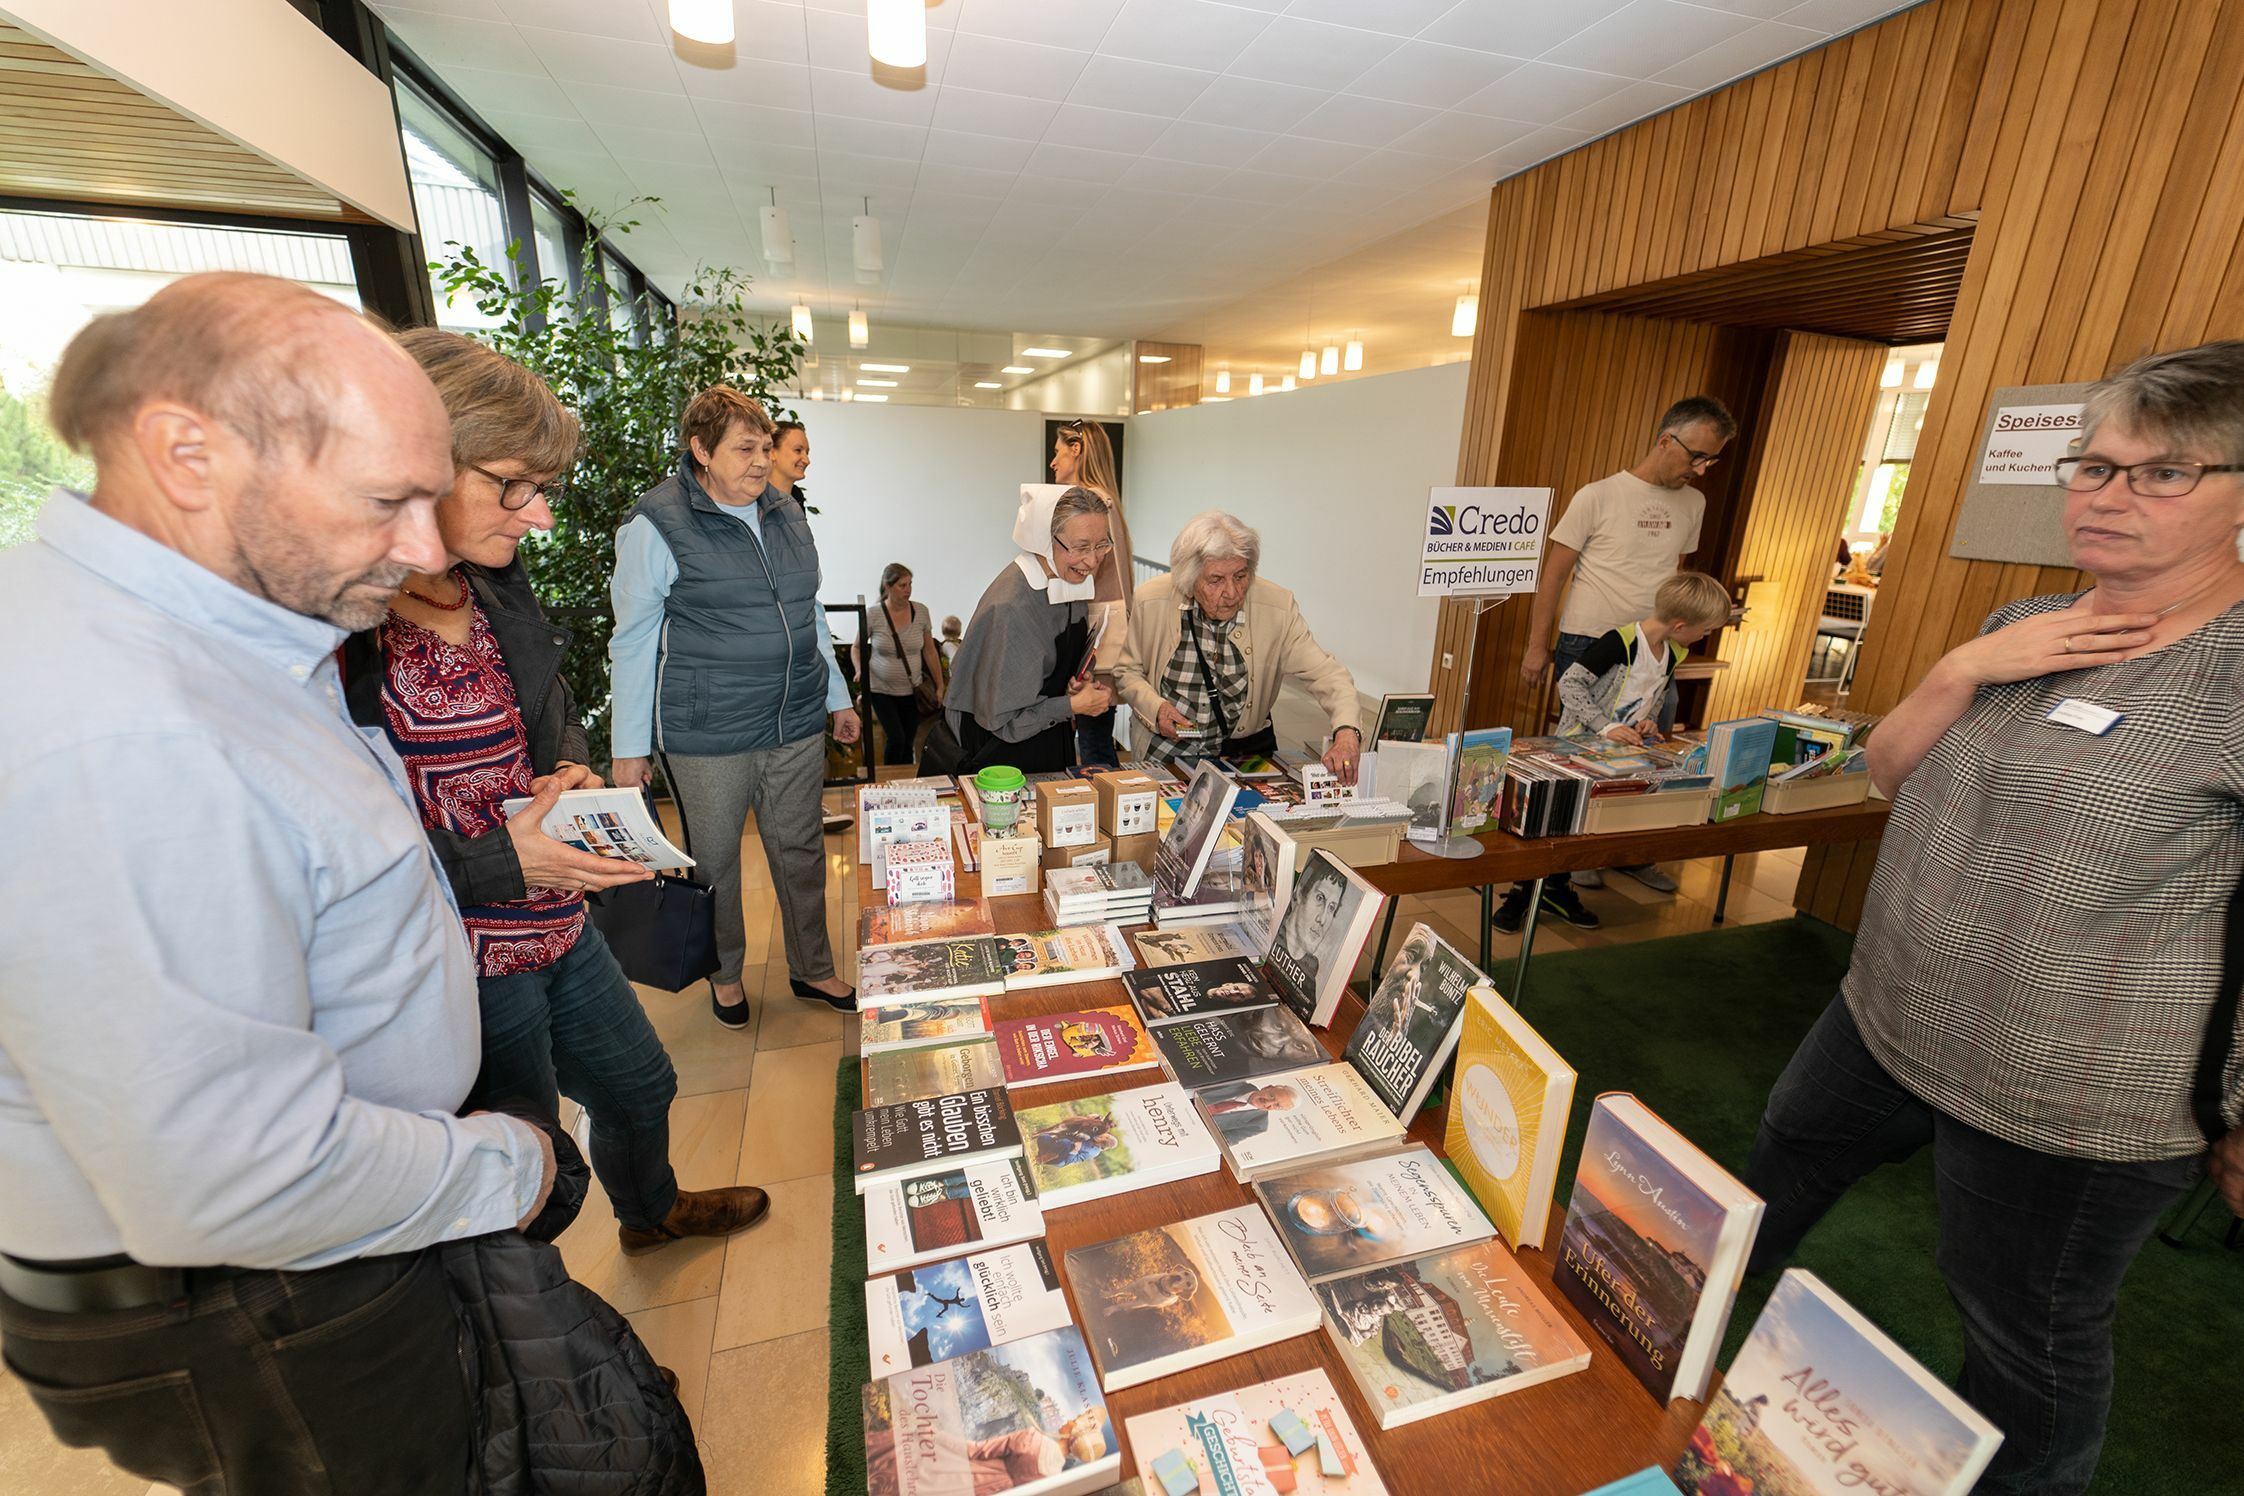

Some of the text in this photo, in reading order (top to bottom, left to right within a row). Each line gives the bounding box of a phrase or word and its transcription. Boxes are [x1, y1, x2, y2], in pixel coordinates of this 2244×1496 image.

[1985, 463, 2052, 472] und Kuchen
[1988, 449, 2023, 459] Kaffee
[1459, 505, 1539, 535] Credo
[1427, 541, 1463, 553] BÜCHER
[1465, 542, 1472, 552] &
[1473, 542, 1507, 552] MEDIEN
[1514, 539, 1536, 551] CAFÉ
[1423, 565, 1534, 588] Empfehlungen
[953, 944, 976, 968] Katie
[1188, 969, 1201, 982] KEIN
[1271, 942, 1306, 988] LUTHER
[1438, 960, 1470, 994] WILHELM
[1164, 972, 1197, 1012] STAHL
[1180, 970, 1201, 998] HERZ AUS
[1439, 980, 1463, 1006] BUNTZ
[1025, 1024, 1048, 1070] IN DER RIKSCHA
[1040, 1029, 1059, 1060] DER ENGEL
[1168, 1027, 1202, 1069] ERFAHREN
[1180, 1025, 1202, 1047] LIEBE
[1193, 1023, 1226, 1058] GELERNT
[1205, 1020, 1227, 1042] HASS
[960, 1048, 975, 1088] Geborgen
[1363, 1030, 1414, 1098] RAUCHER
[1378, 1027, 1423, 1078] DER BIBEL
[970, 1091, 997, 1146] Ein bisschen
[1300, 1077, 1324, 1105] meines
[1320, 1105, 1347, 1134] Lebens
[1313, 1074, 1363, 1132] Streiflichter
[1342, 1070, 1370, 1101] GERHARD
[1369, 1101, 1390, 1125] MAIER
[865, 1111, 880, 1153] umkrempelt
[880, 1108, 895, 1147] mein Leben
[894, 1105, 909, 1134] Wie Gott
[912, 1101, 943, 1159] gibt es nicht
[939, 1095, 972, 1152] Glauben
[1142, 1094, 1179, 1148] henry
[969, 1179, 996, 1222] geliebt!
[990, 1187, 1010, 1223] wirklich
[1000, 1174, 1018, 1205] Ich bin
[1387, 1173, 1412, 1204] MEINEM
[1408, 1203, 1432, 1230] LEBEN
[1398, 1160, 1462, 1235] Segensspuren
[1603, 1151, 1688, 1230] Lynn Austin
[1218, 1217, 1264, 1260] Bleib
[1254, 1264, 1266, 1278] an
[973, 1261, 1007, 1337] glücklich sein
[993, 1271, 1013, 1310] einfach
[1000, 1255, 1023, 1302] Ich wollte
[1232, 1251, 1276, 1314] meiner Seite
[1470, 1262, 1521, 1317] Die Leute
[1582, 1241, 1621, 1291] Ufer
[1623, 1290, 1657, 1330] der
[1565, 1247, 1665, 1371] Erinnerung
[934, 1373, 946, 1393] Die
[1067, 1347, 1081, 1377] JULIE
[899, 1409, 909, 1429] des
[911, 1374, 938, 1463] Tochter
[1781, 1366, 1860, 1436] Alles
[1782, 1399, 1859, 1463] wird
